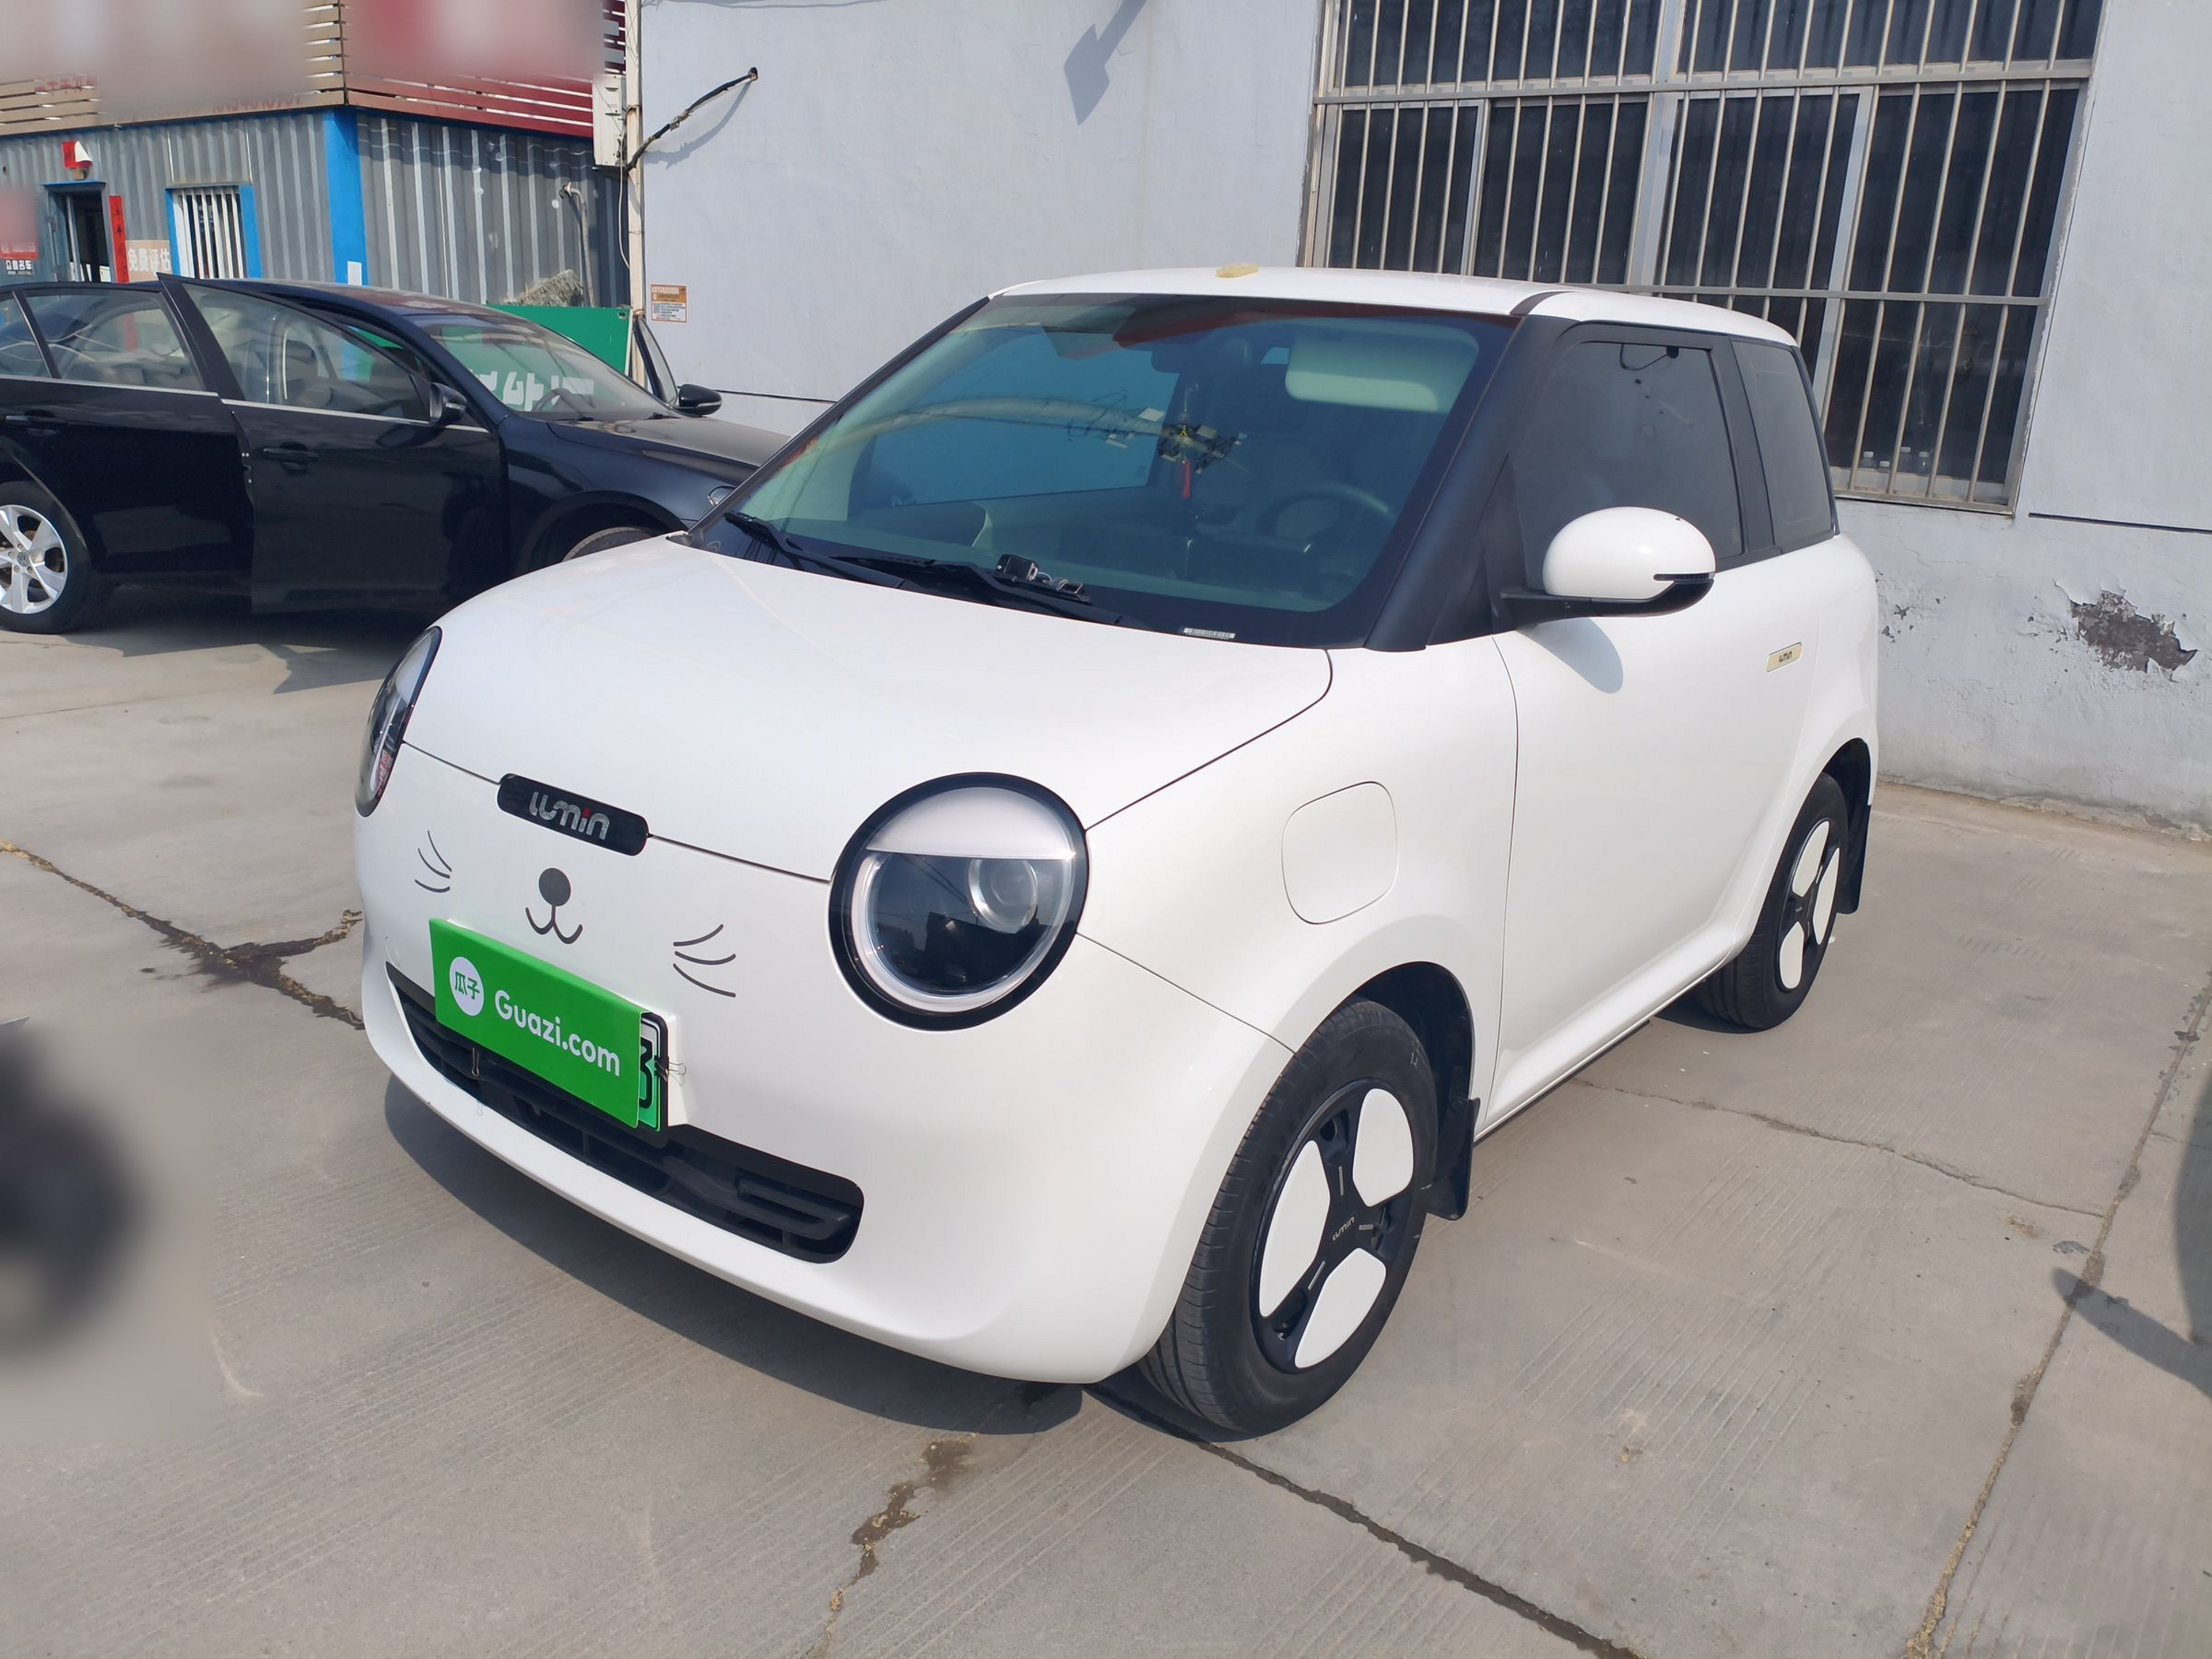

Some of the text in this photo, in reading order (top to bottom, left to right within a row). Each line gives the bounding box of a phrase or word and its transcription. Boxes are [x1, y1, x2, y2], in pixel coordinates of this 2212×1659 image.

[128, 247, 170, 271] 免费评估
[454, 969, 480, 1000] 瓜子
[494, 989, 620, 1077] Guazi.com
